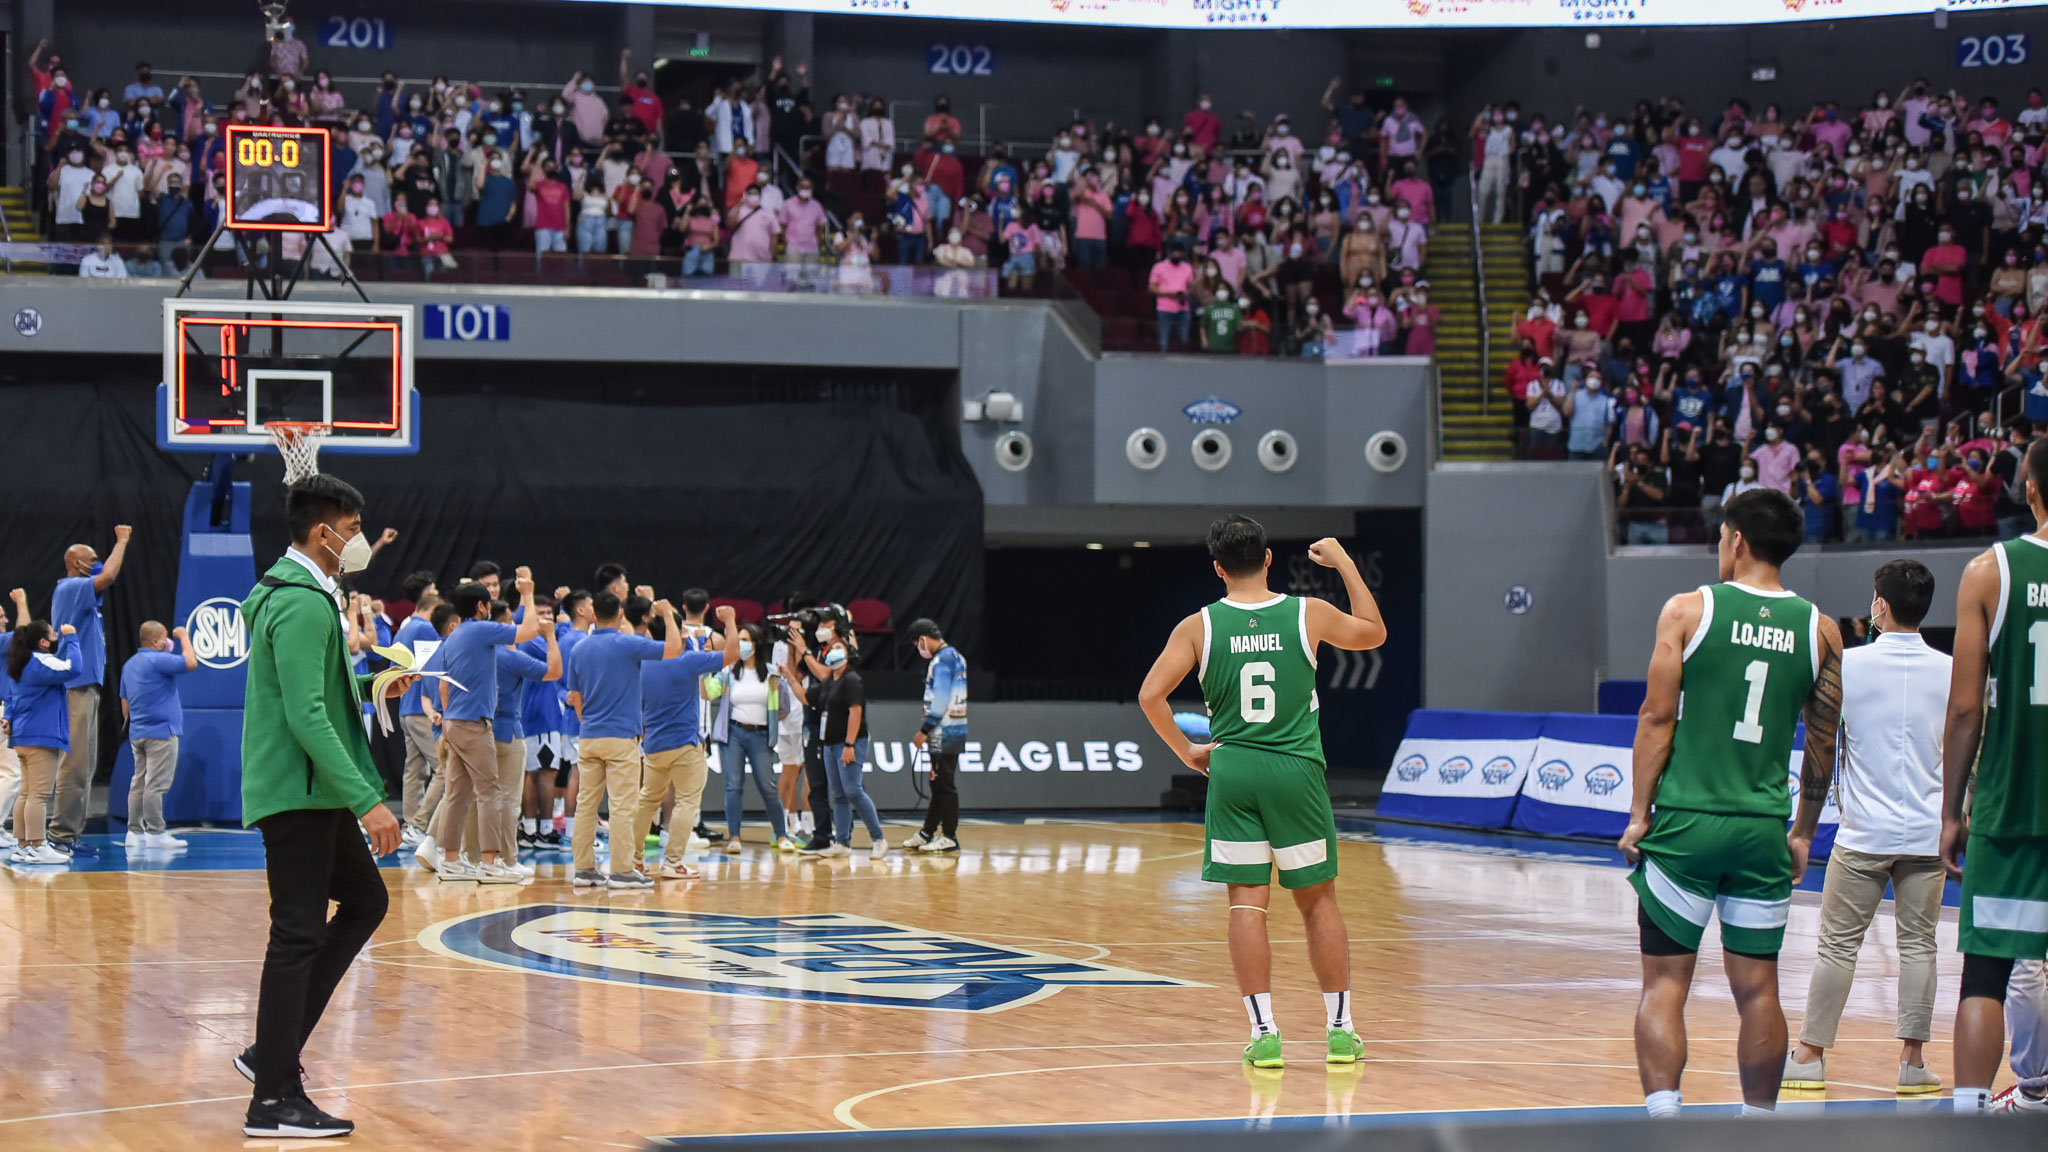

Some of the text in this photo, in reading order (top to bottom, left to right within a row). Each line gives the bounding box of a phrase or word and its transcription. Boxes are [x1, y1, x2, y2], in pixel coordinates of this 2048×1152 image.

[327, 16, 386, 49] 201
[930, 43, 992, 75] 202
[1960, 34, 2026, 67] 203
[436, 303, 497, 341] 101
[192, 605, 247, 660] SM
[1229, 633, 1284, 654] MANUEL
[1730, 619, 1796, 655] LOJERA
[1239, 661, 1276, 724] 6
[1732, 659, 1770, 745] 1
[958, 740, 1144, 773] EAGLES
